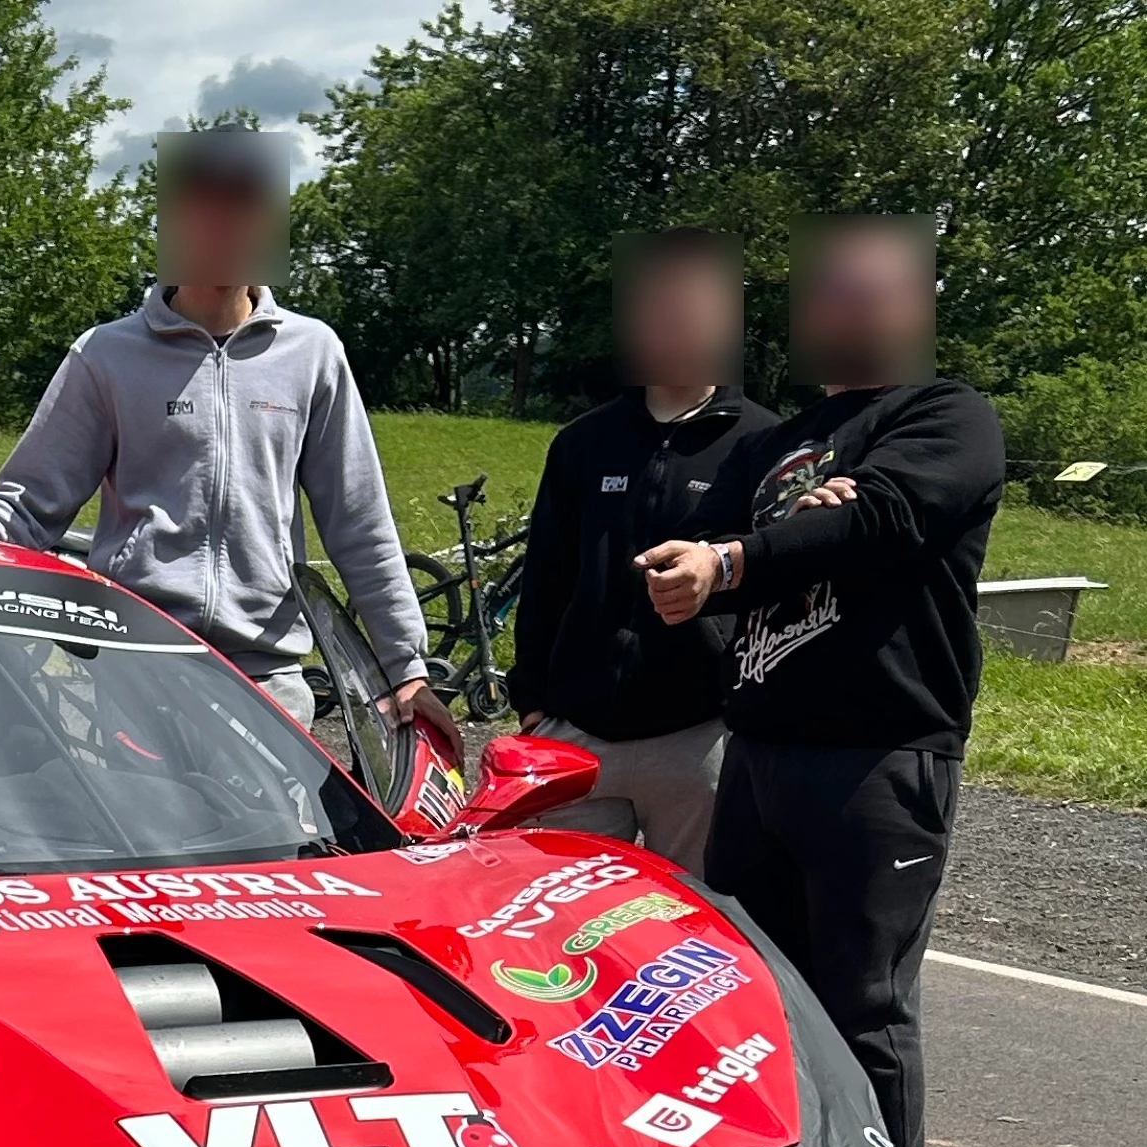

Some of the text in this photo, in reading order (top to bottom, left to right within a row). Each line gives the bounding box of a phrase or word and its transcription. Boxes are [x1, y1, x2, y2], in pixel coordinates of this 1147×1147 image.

[66, 613, 129, 634] TEAM
[68, 869, 383, 906] AUSTRIA
[122, 895, 328, 924] Macedonia
[456, 853, 625, 939] CARGOMAX
[501, 863, 639, 940] IVECO
[561, 892, 678, 955] GREEN
[610, 964, 752, 1071] PHARMACY
[682, 1033, 777, 1103] triglav
